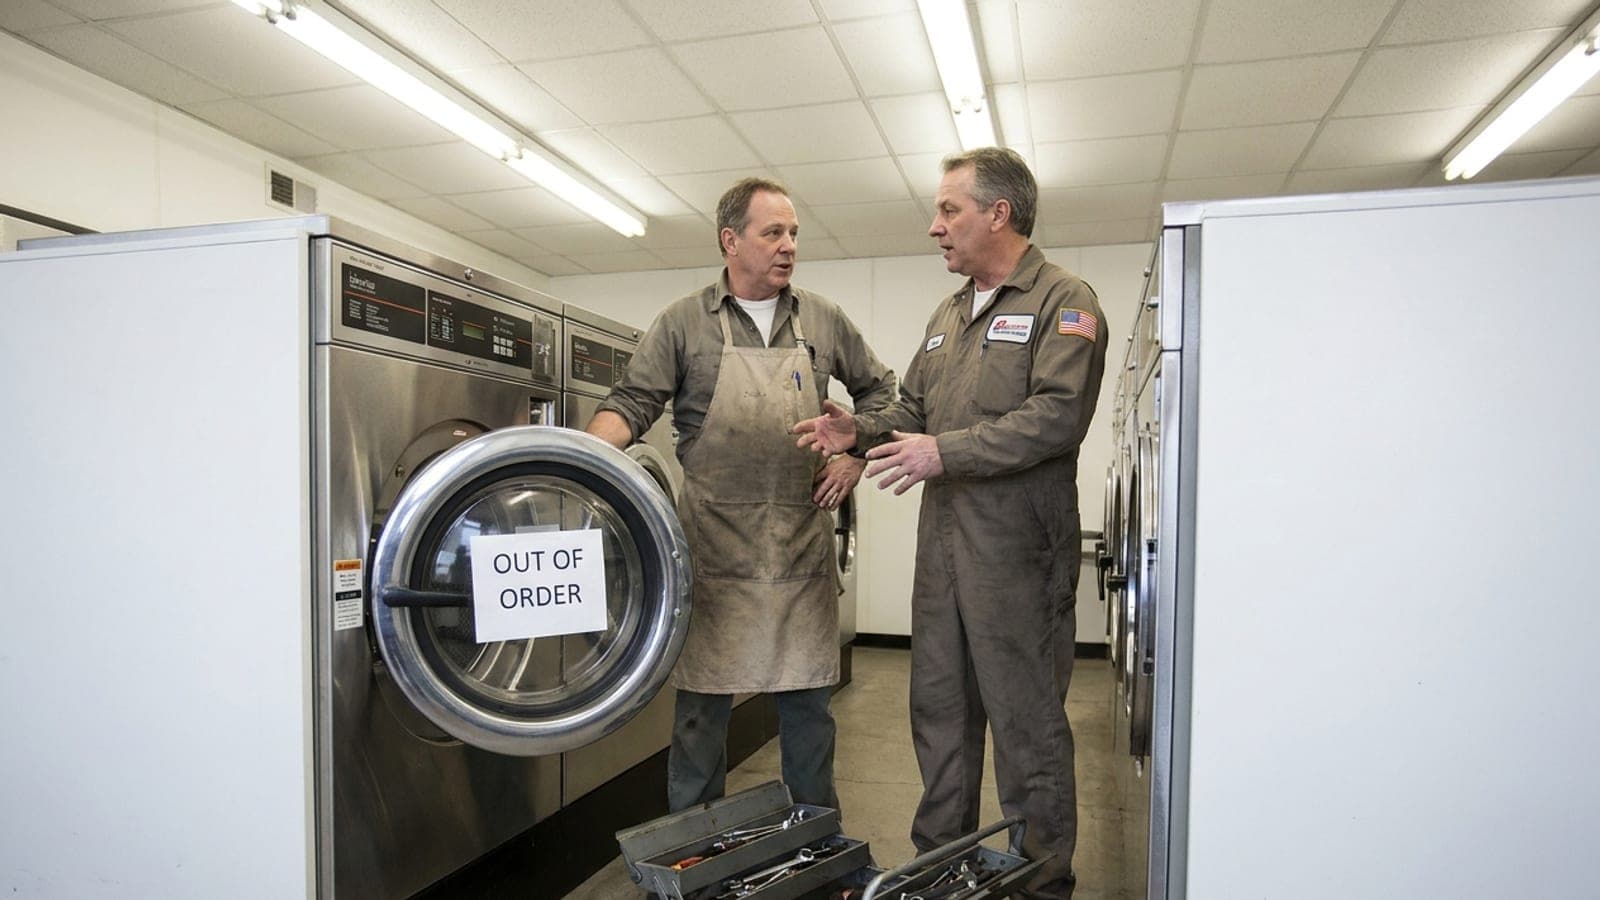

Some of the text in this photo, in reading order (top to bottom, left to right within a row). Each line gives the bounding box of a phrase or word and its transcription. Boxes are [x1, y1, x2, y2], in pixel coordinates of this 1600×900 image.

[494, 549, 583, 574] OUT OF
[500, 584, 582, 609] ORDER
